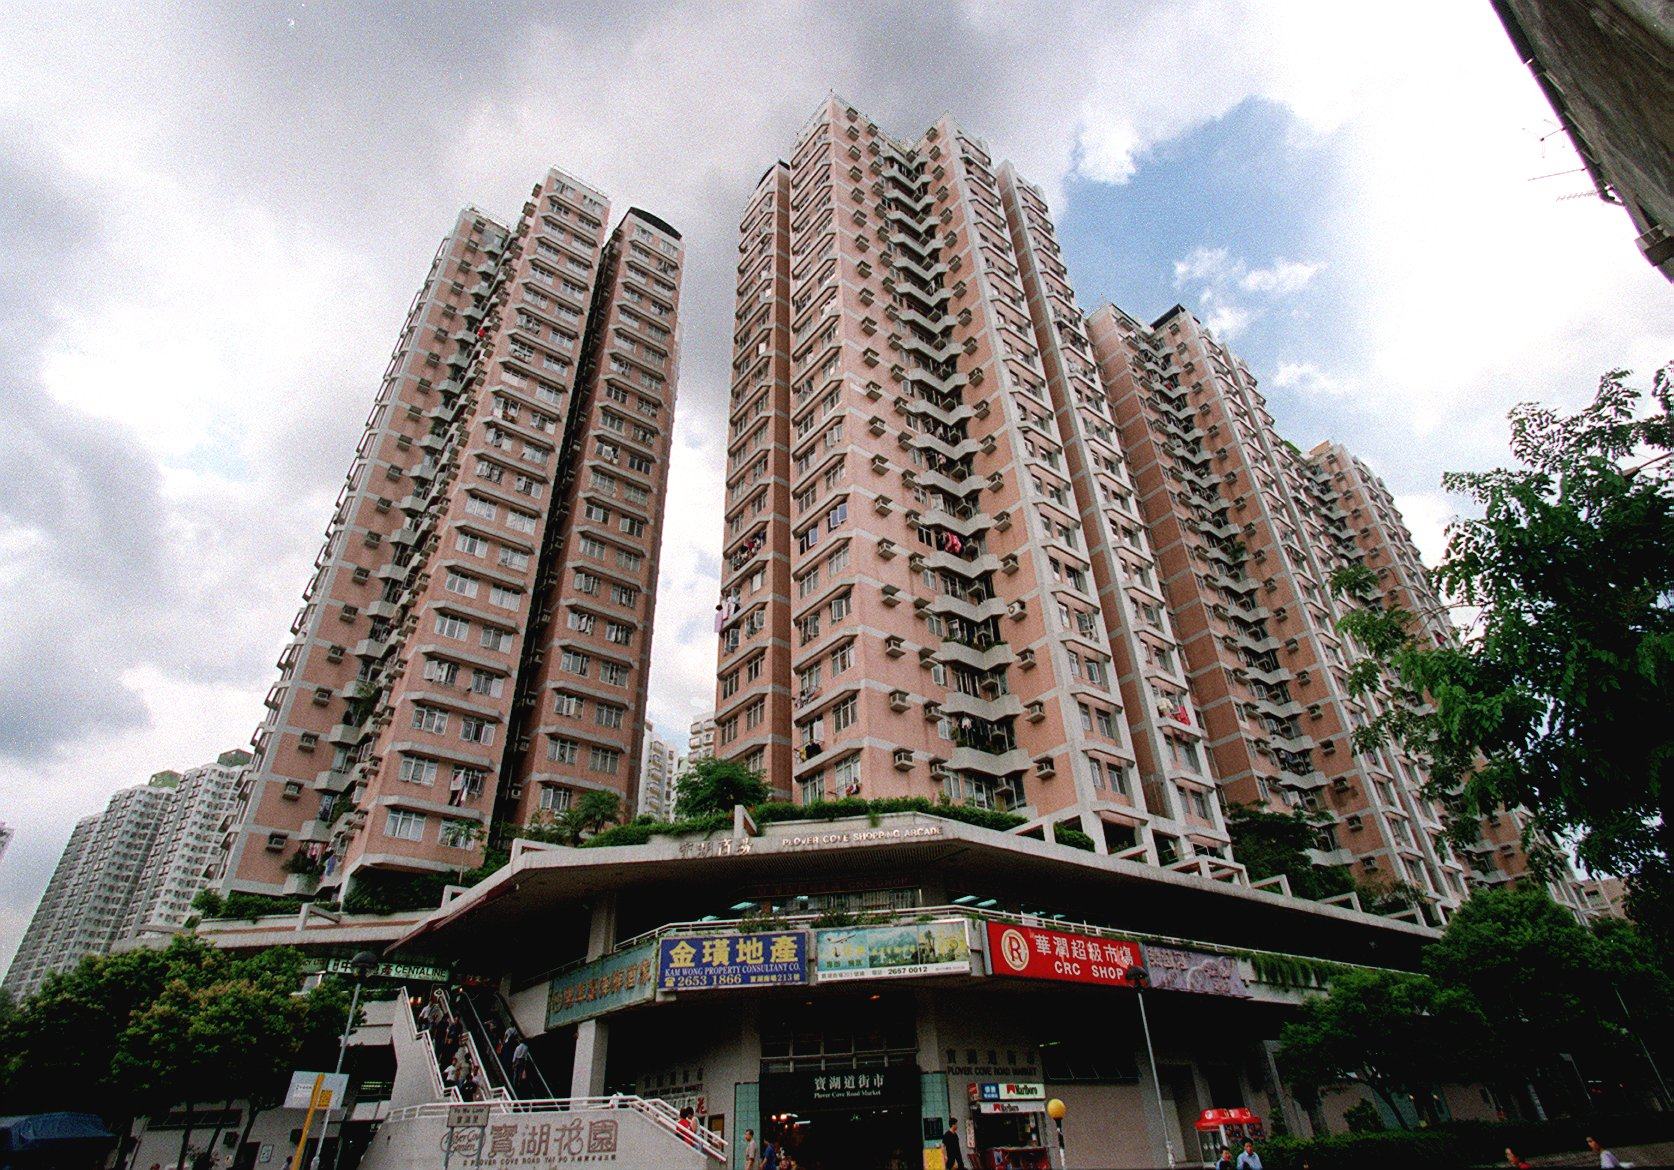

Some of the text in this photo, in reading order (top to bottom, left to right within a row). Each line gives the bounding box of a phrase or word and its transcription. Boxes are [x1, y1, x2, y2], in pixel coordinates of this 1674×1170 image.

[782, 826, 943, 846] PLOVER COVE SHOPPING ARCADE
[668, 935, 799, 967] 金璜地產
[1034, 934, 1134, 966] 華潤超級市場
[395, 964, 447, 978] CENTALINE
[665, 963, 800, 976] KAM WONG PROPERTY CONSULTANT CO.
[1054, 961, 1124, 979] CRC SHOP
[677, 974, 742, 987] 2653 1866
[814, 1073, 885, 1091] 寶湖道街市
[488, 1117, 619, 1158] 寶湖花園
[500, 1157, 518, 1165] COVE
